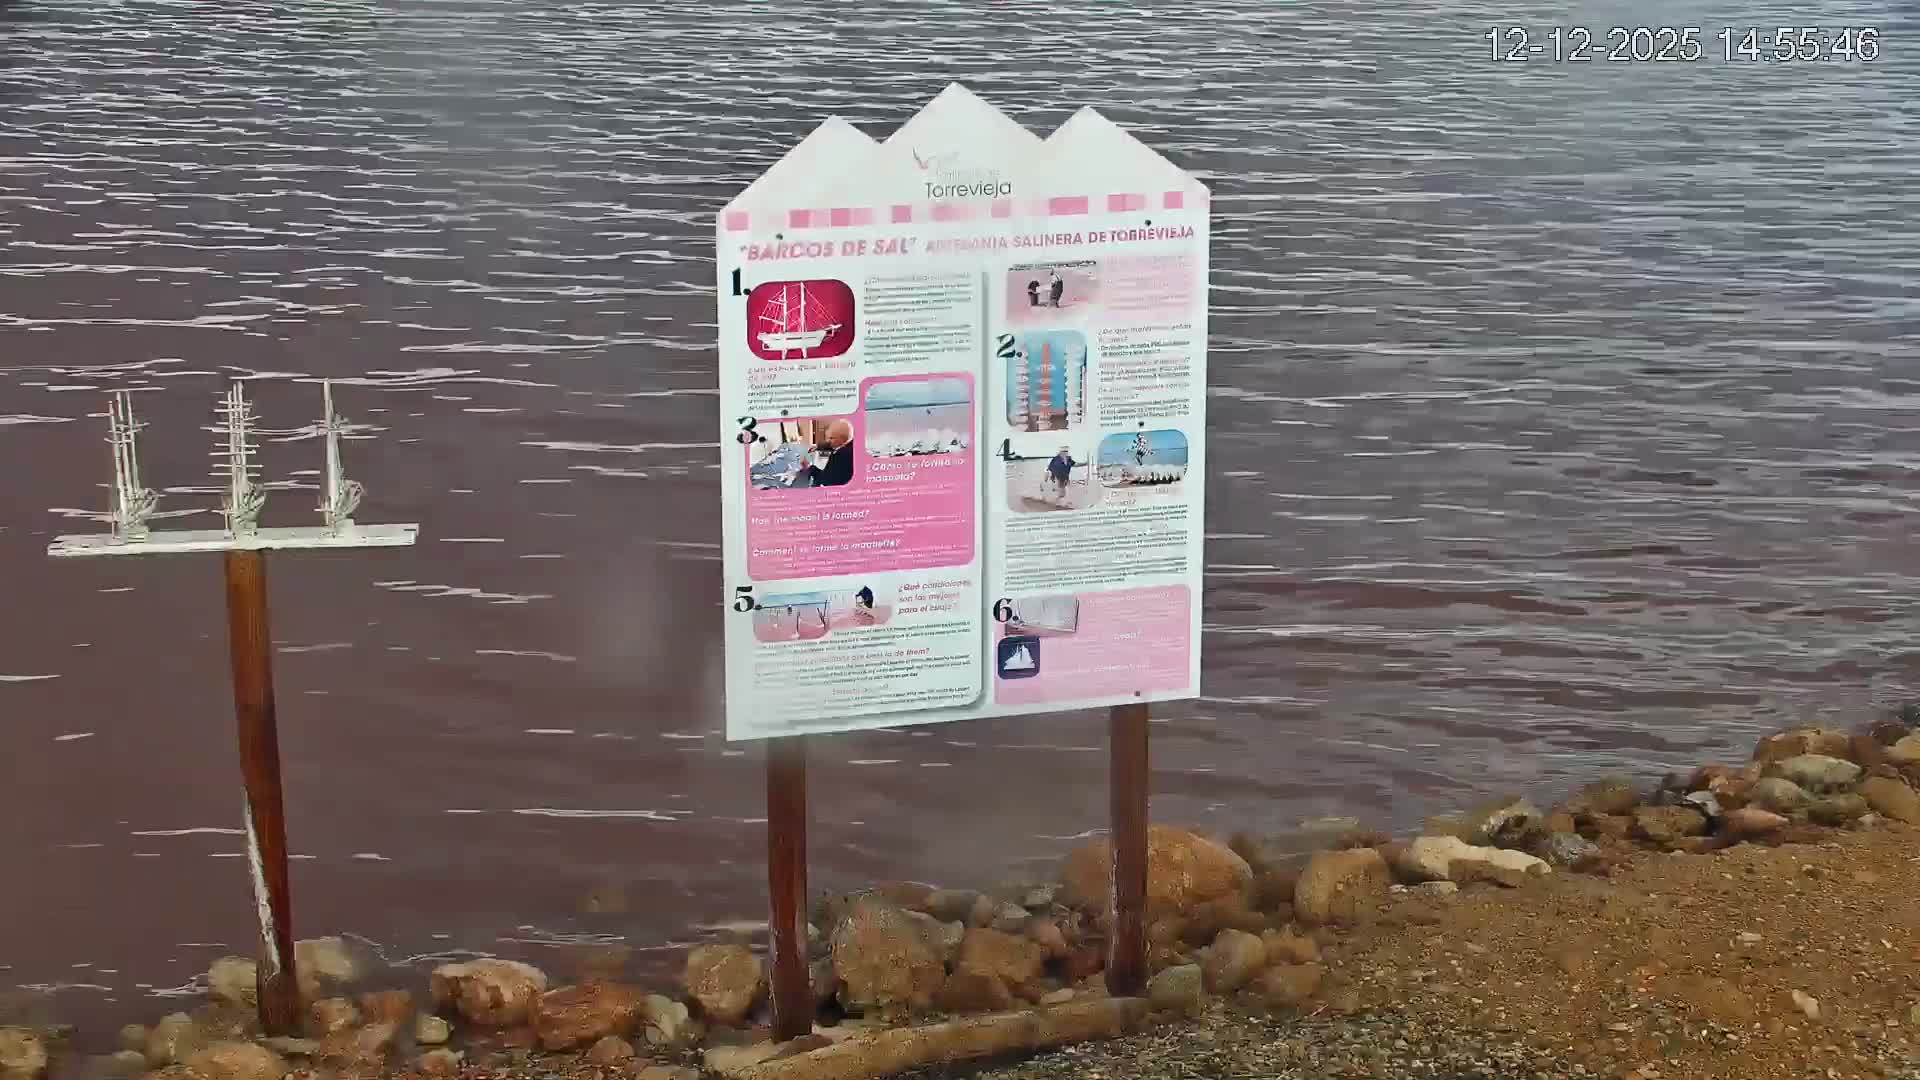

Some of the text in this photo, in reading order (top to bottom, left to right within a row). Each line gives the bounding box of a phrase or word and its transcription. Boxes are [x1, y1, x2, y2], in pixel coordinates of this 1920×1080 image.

[925, 179, 1012, 199] Torrevieja
[841, 240, 867, 257] DE
[1013, 231, 1083, 248] SALINERA
[1088, 231, 1107, 243] DE
[1110, 225, 1194, 242] TORREVIEJA
[996, 333, 1023, 359] 2.
[736, 416, 767, 444] 3.
[733, 585, 763, 613] 5.
[898, 606, 918, 616] para
[993, 597, 1020, 623] 6.
[905, 647, 931, 657] them?
